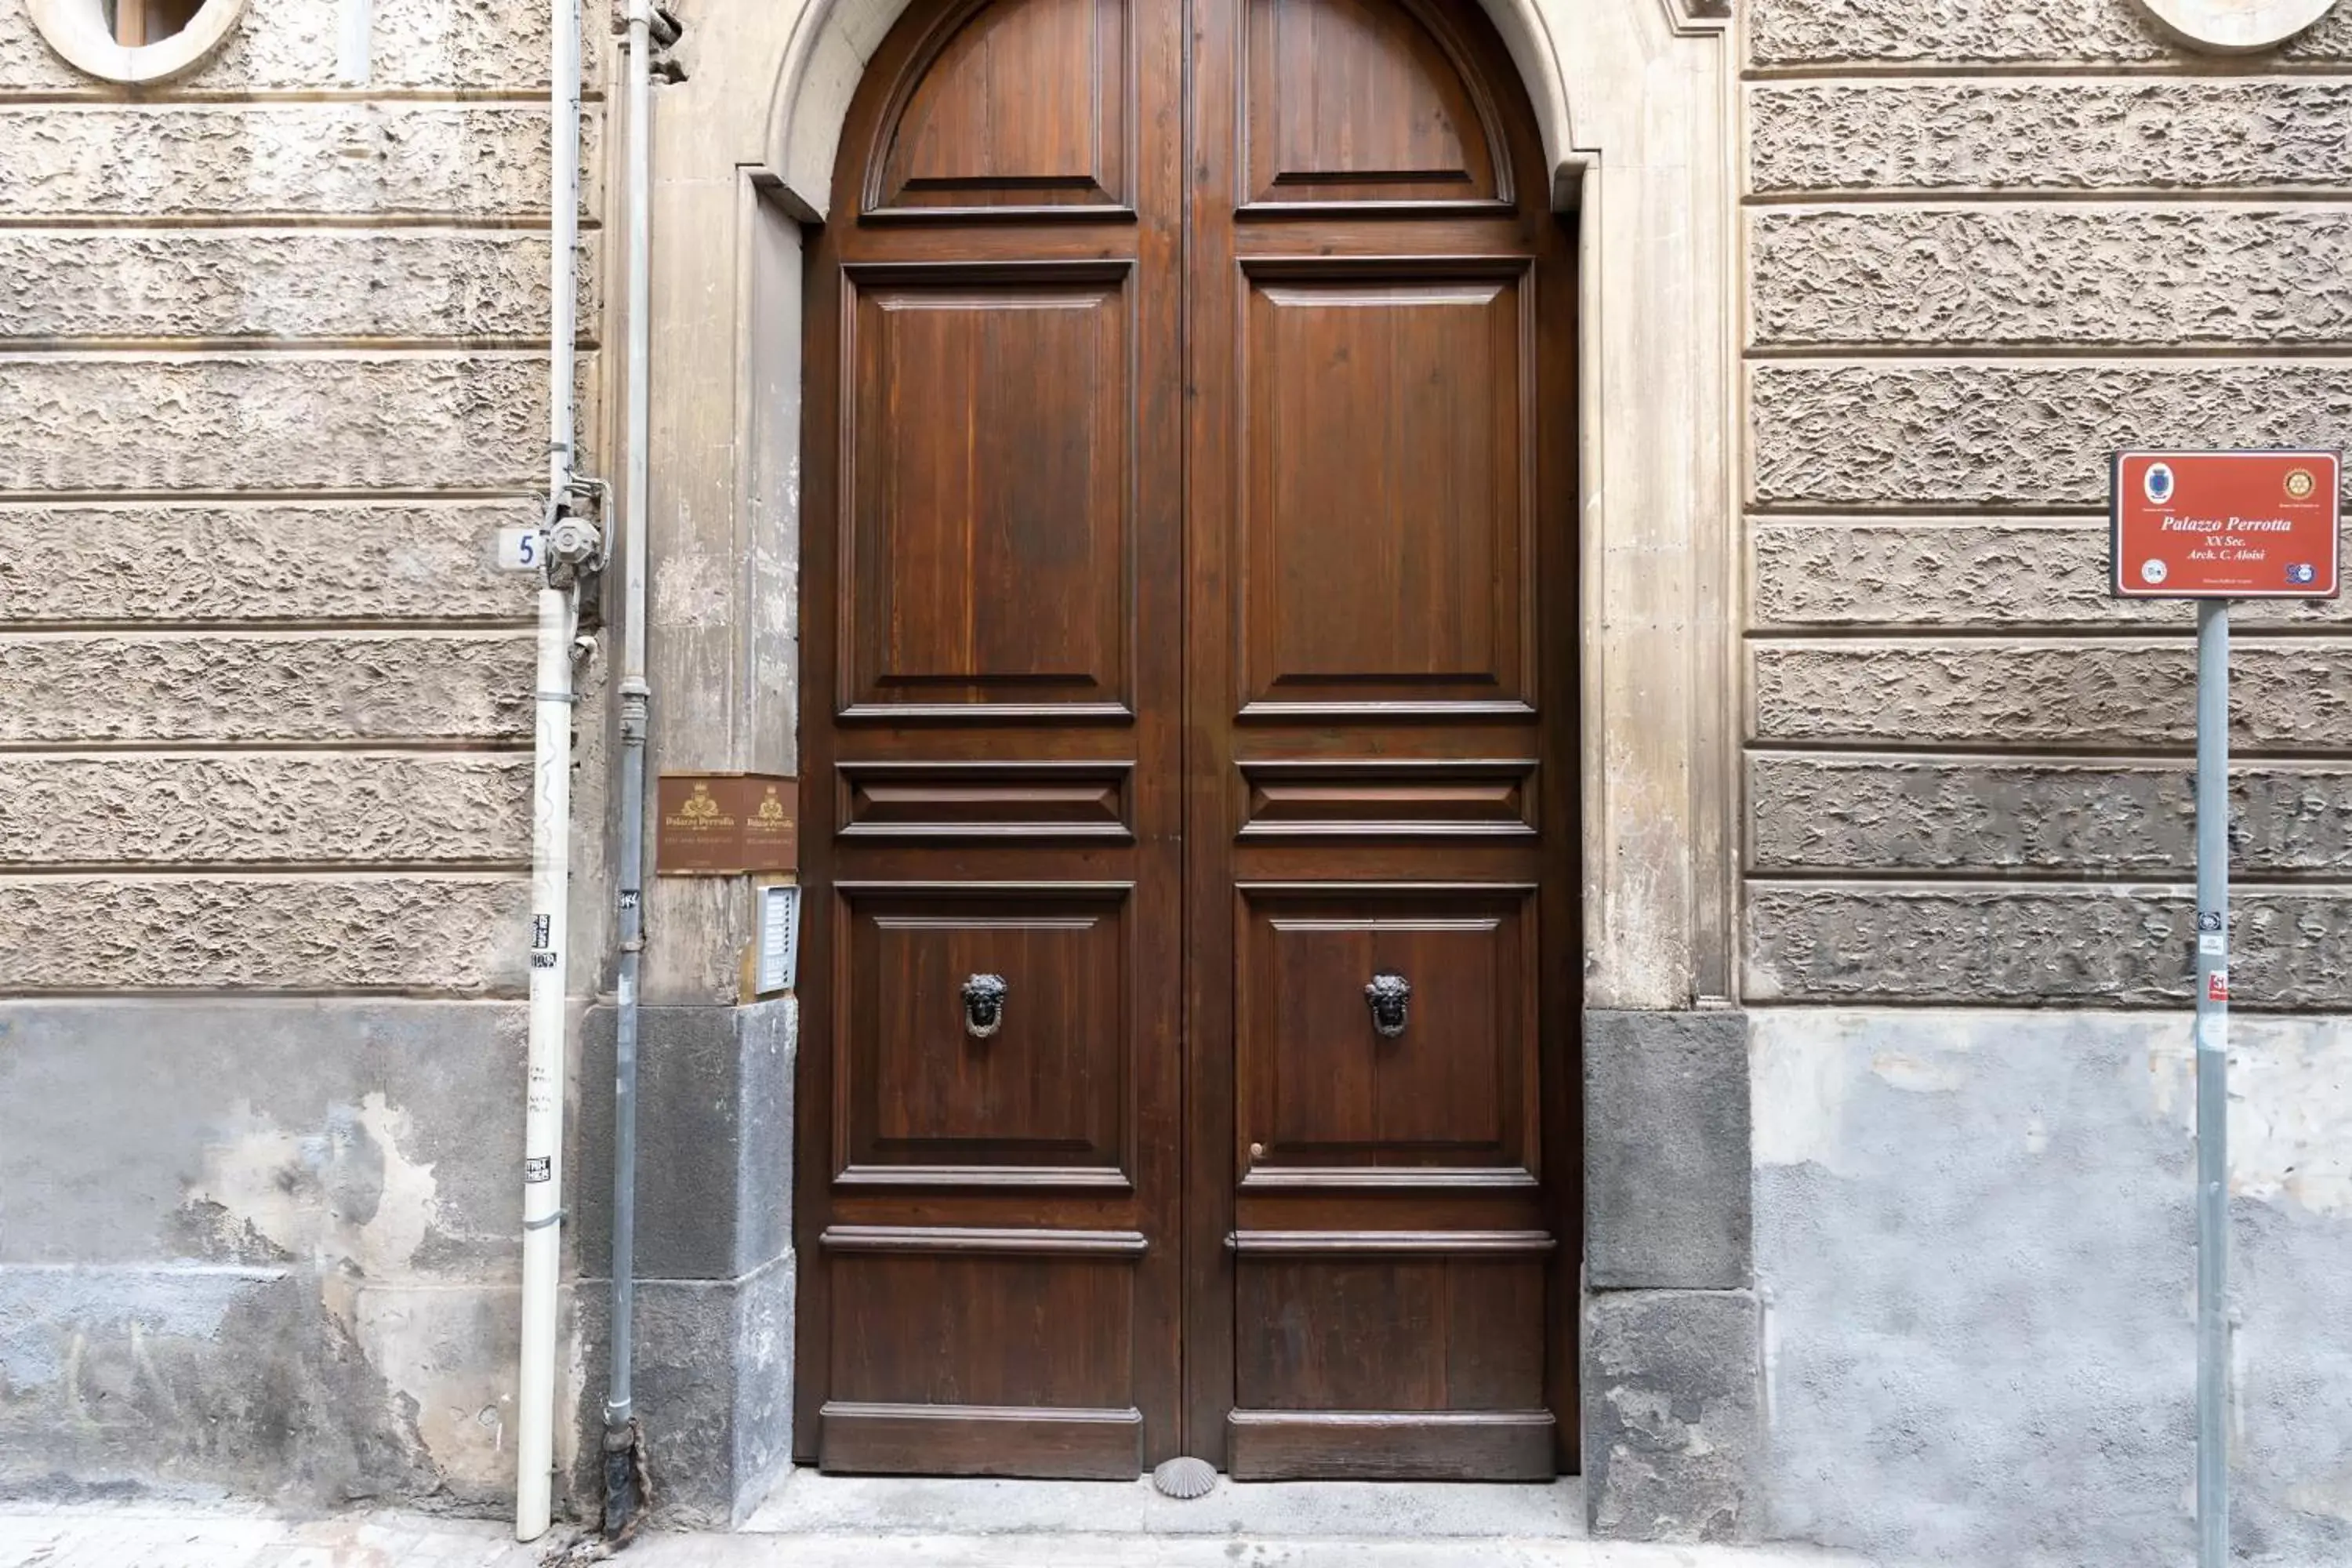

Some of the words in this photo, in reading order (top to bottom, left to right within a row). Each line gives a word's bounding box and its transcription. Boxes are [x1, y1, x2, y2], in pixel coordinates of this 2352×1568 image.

[2161, 516, 2223, 532] Palazzo
[2226, 516, 2292, 532] Perrotta
[2205, 535, 2223, 546] XX
[2224, 535, 2246, 546] Sec.
[520, 535, 533, 564] 5
[2187, 550, 2218, 561] Arch.
[2220, 550, 2231, 561] C.
[2234, 550, 2267, 561] Aloisi
